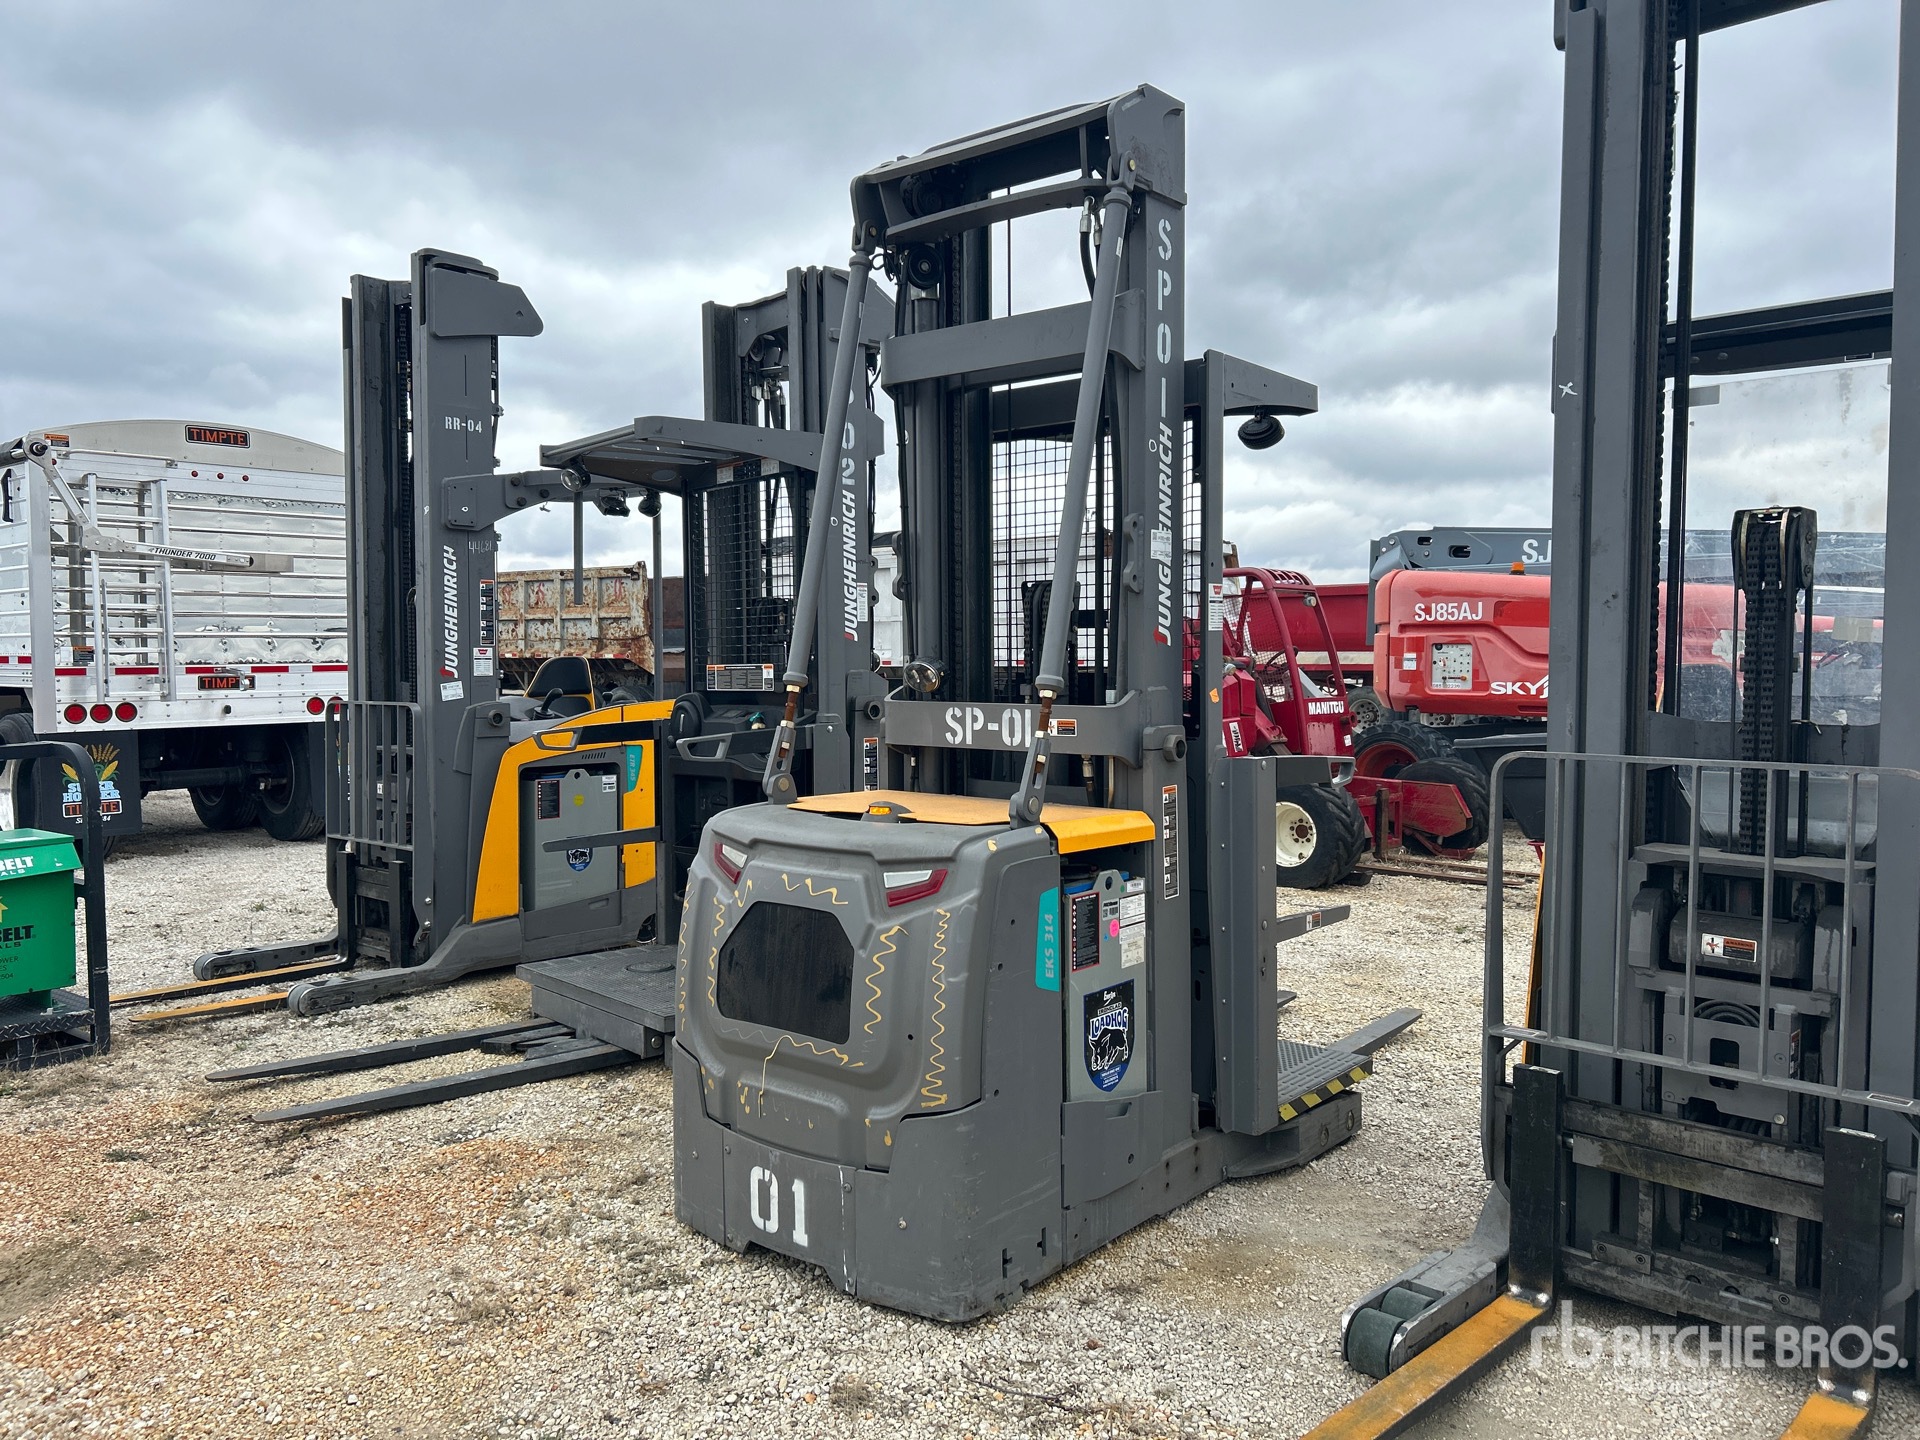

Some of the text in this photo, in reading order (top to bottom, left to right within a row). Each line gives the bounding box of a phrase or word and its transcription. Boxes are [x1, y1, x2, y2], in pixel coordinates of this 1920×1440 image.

[445, 416, 482, 433] RR-04
[190, 428, 246, 446] TIMPTE
[1156, 421, 1172, 646] JUNGEINRICH
[154, 546, 217, 561] THUNDER 7000
[842, 489, 858, 642] JUNGHEINRICH
[441, 545, 458, 679] JUNGHEINRICH
[1414, 601, 1483, 622] SJ85AJ
[1307, 700, 1345, 715] MANITOU
[63, 789, 121, 802] HOER
[66, 801, 119, 816] TITE
[1045, 914, 1054, 978] EKS 314
[1090, 1008, 1128, 1039] LOADHOG
[750, 1166, 808, 1247] 01
